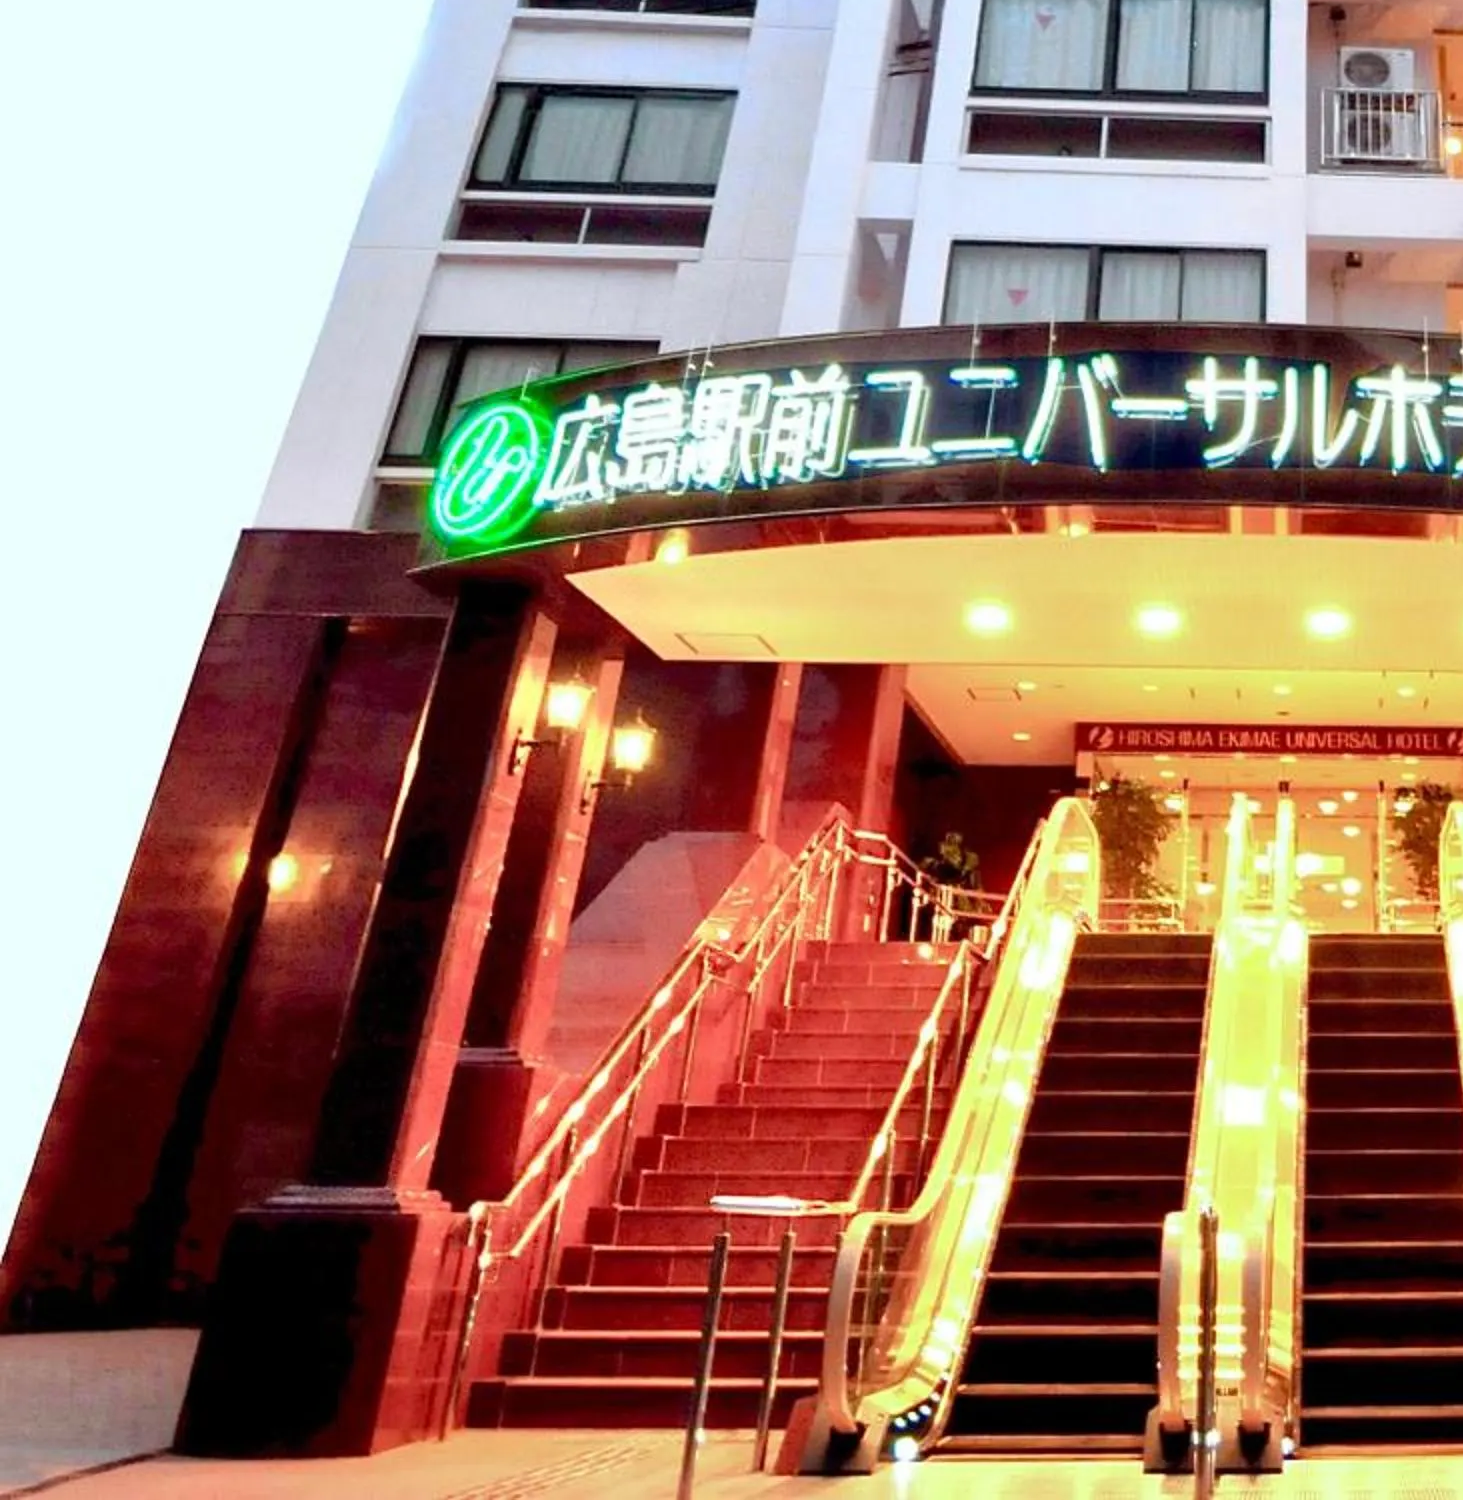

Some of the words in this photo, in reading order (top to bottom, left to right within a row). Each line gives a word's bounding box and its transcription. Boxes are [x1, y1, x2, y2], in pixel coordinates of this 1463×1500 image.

[1118, 729, 1213, 748] HIROSHIMA
[1219, 731, 1281, 748] EKIMAE
[1286, 731, 1382, 749] UNIVERSAL
[1387, 732, 1443, 749] HOTEL
